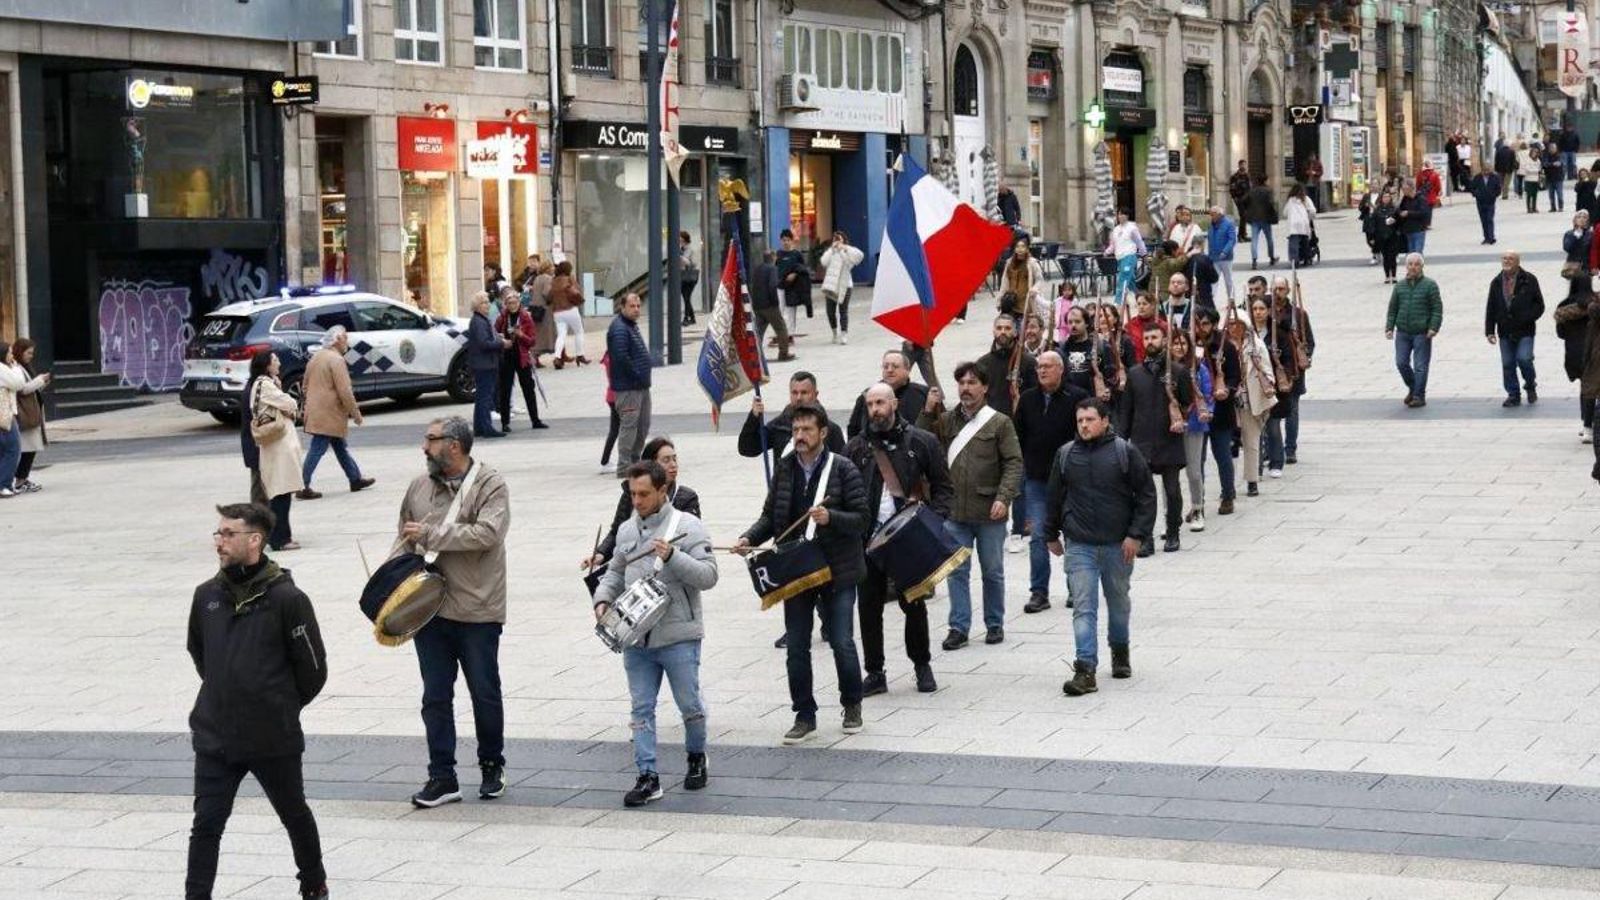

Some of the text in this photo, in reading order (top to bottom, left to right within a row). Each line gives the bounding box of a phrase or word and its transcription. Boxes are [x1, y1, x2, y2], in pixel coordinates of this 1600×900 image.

[1563, 48, 1584, 74] R
[597, 126, 615, 145] AS
[203, 320, 231, 336] 092
[756, 566, 780, 592] R
